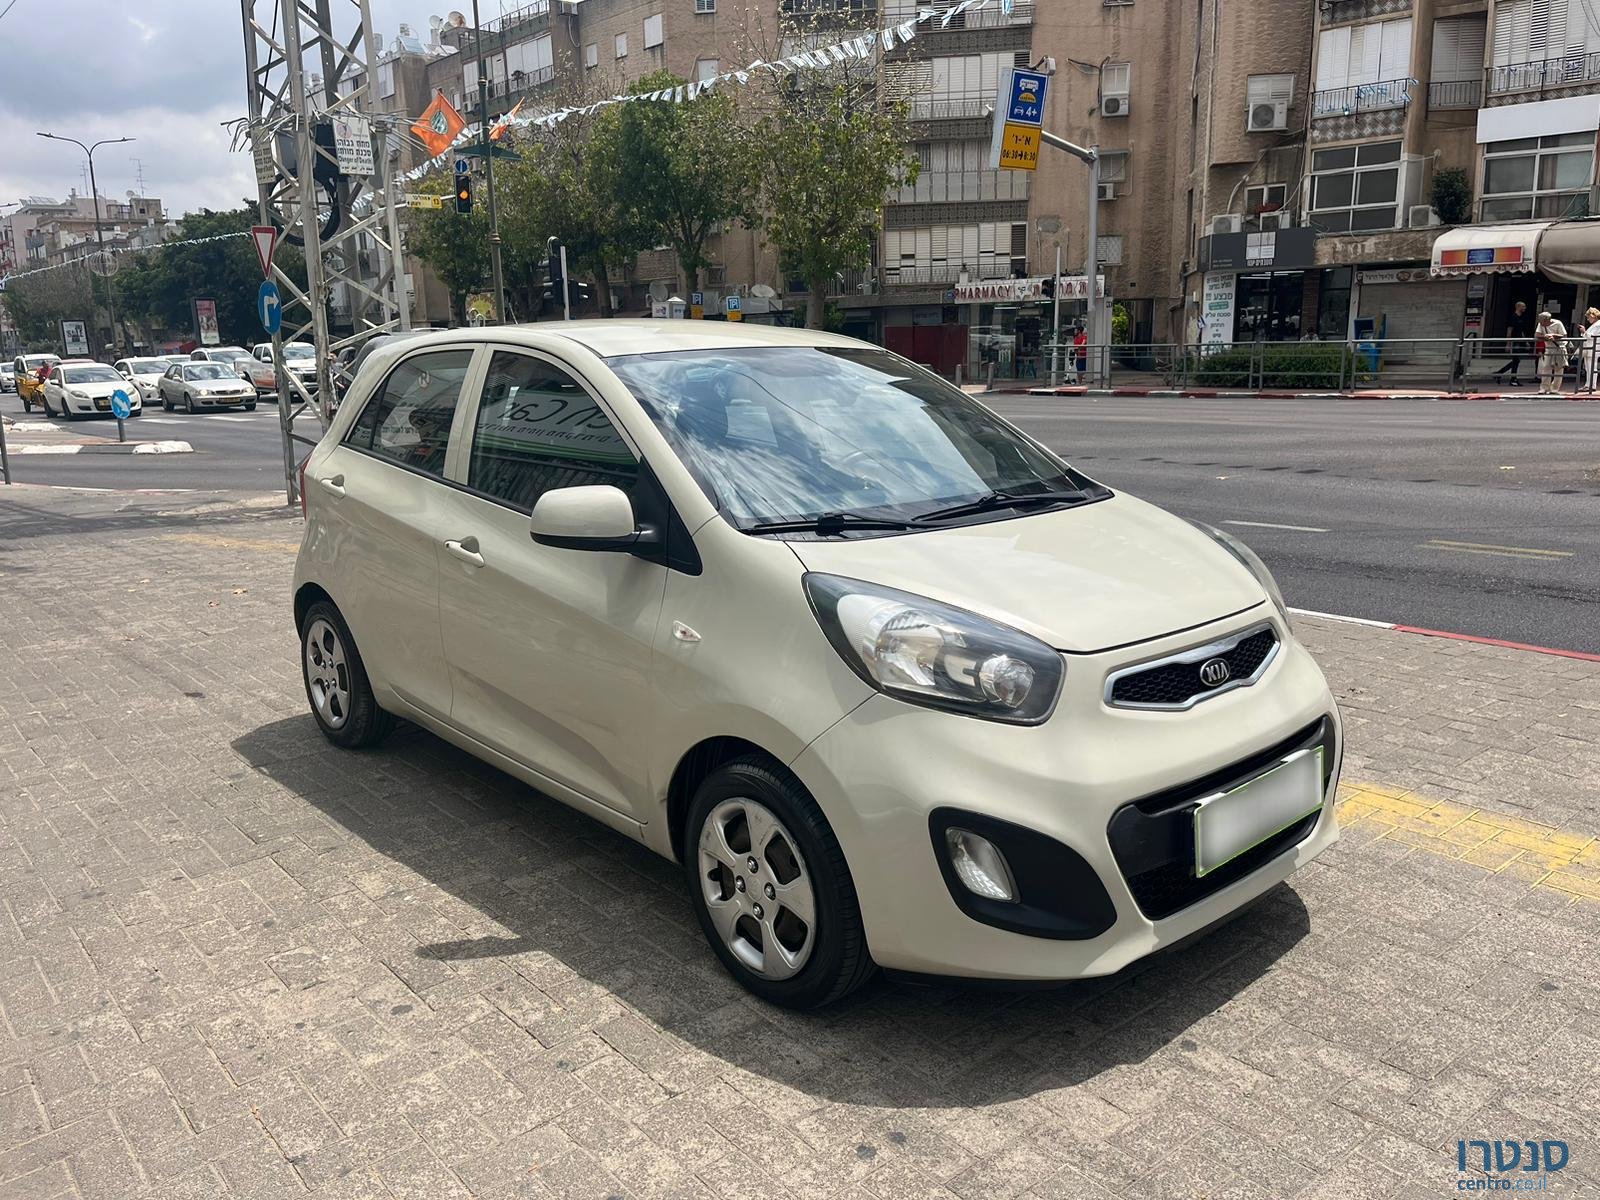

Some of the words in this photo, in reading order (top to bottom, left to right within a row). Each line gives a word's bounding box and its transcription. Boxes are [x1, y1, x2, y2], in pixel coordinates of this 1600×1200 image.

[1026, 106, 1038, 117] 4+
[356, 140, 371, 148] מתח
[355, 148, 372, 157] סכנת
[338, 155, 354, 164] Danger
[954, 284, 1011, 300] PHARMACY
[1204, 661, 1229, 681] KIA
